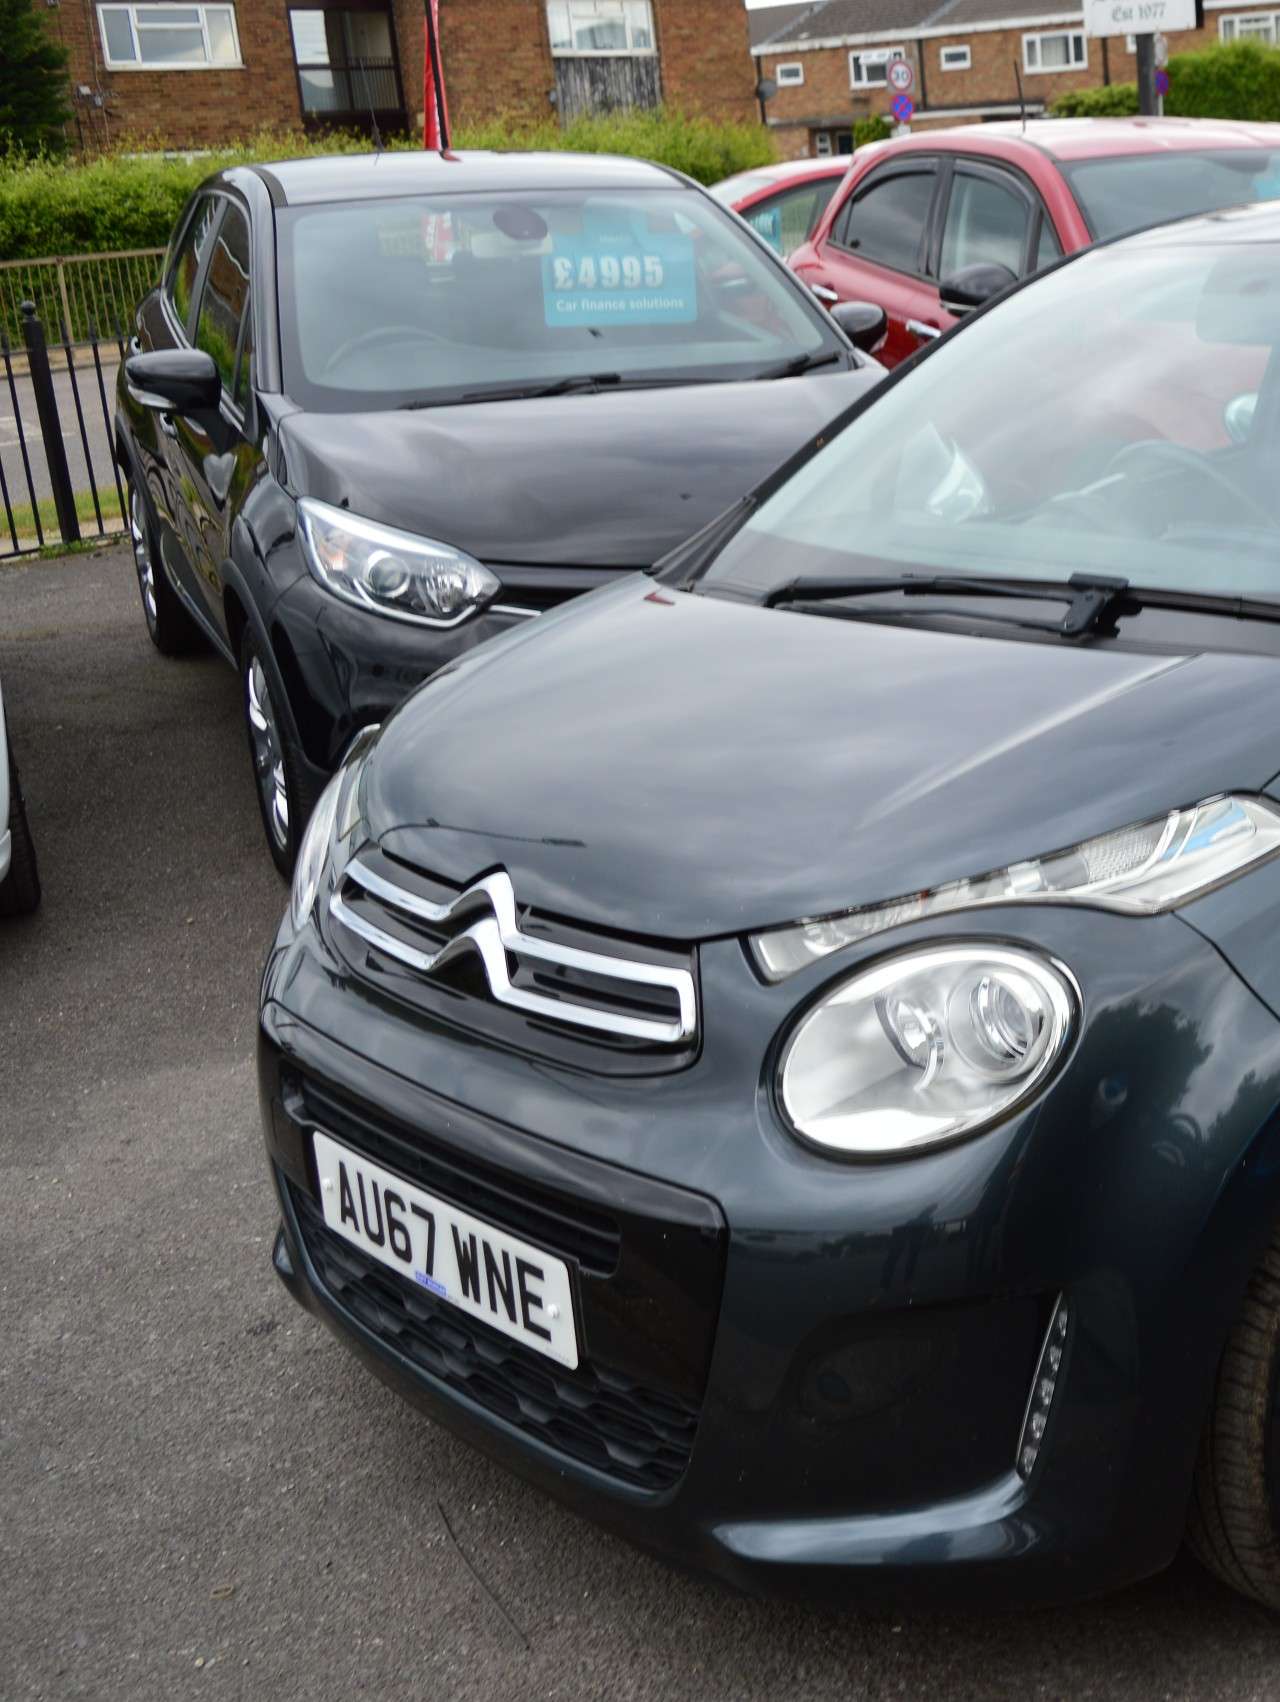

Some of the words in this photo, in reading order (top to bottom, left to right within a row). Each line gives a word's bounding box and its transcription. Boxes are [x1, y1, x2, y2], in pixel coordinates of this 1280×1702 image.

[893, 70, 909, 82] 30
[553, 256, 664, 290] £4995
[556, 299, 577, 313] Car
[581, 297, 626, 312] finance
[629, 294, 686, 310] solutions
[338, 1160, 436, 1278] AU67
[450, 1222, 552, 1343] WNE
